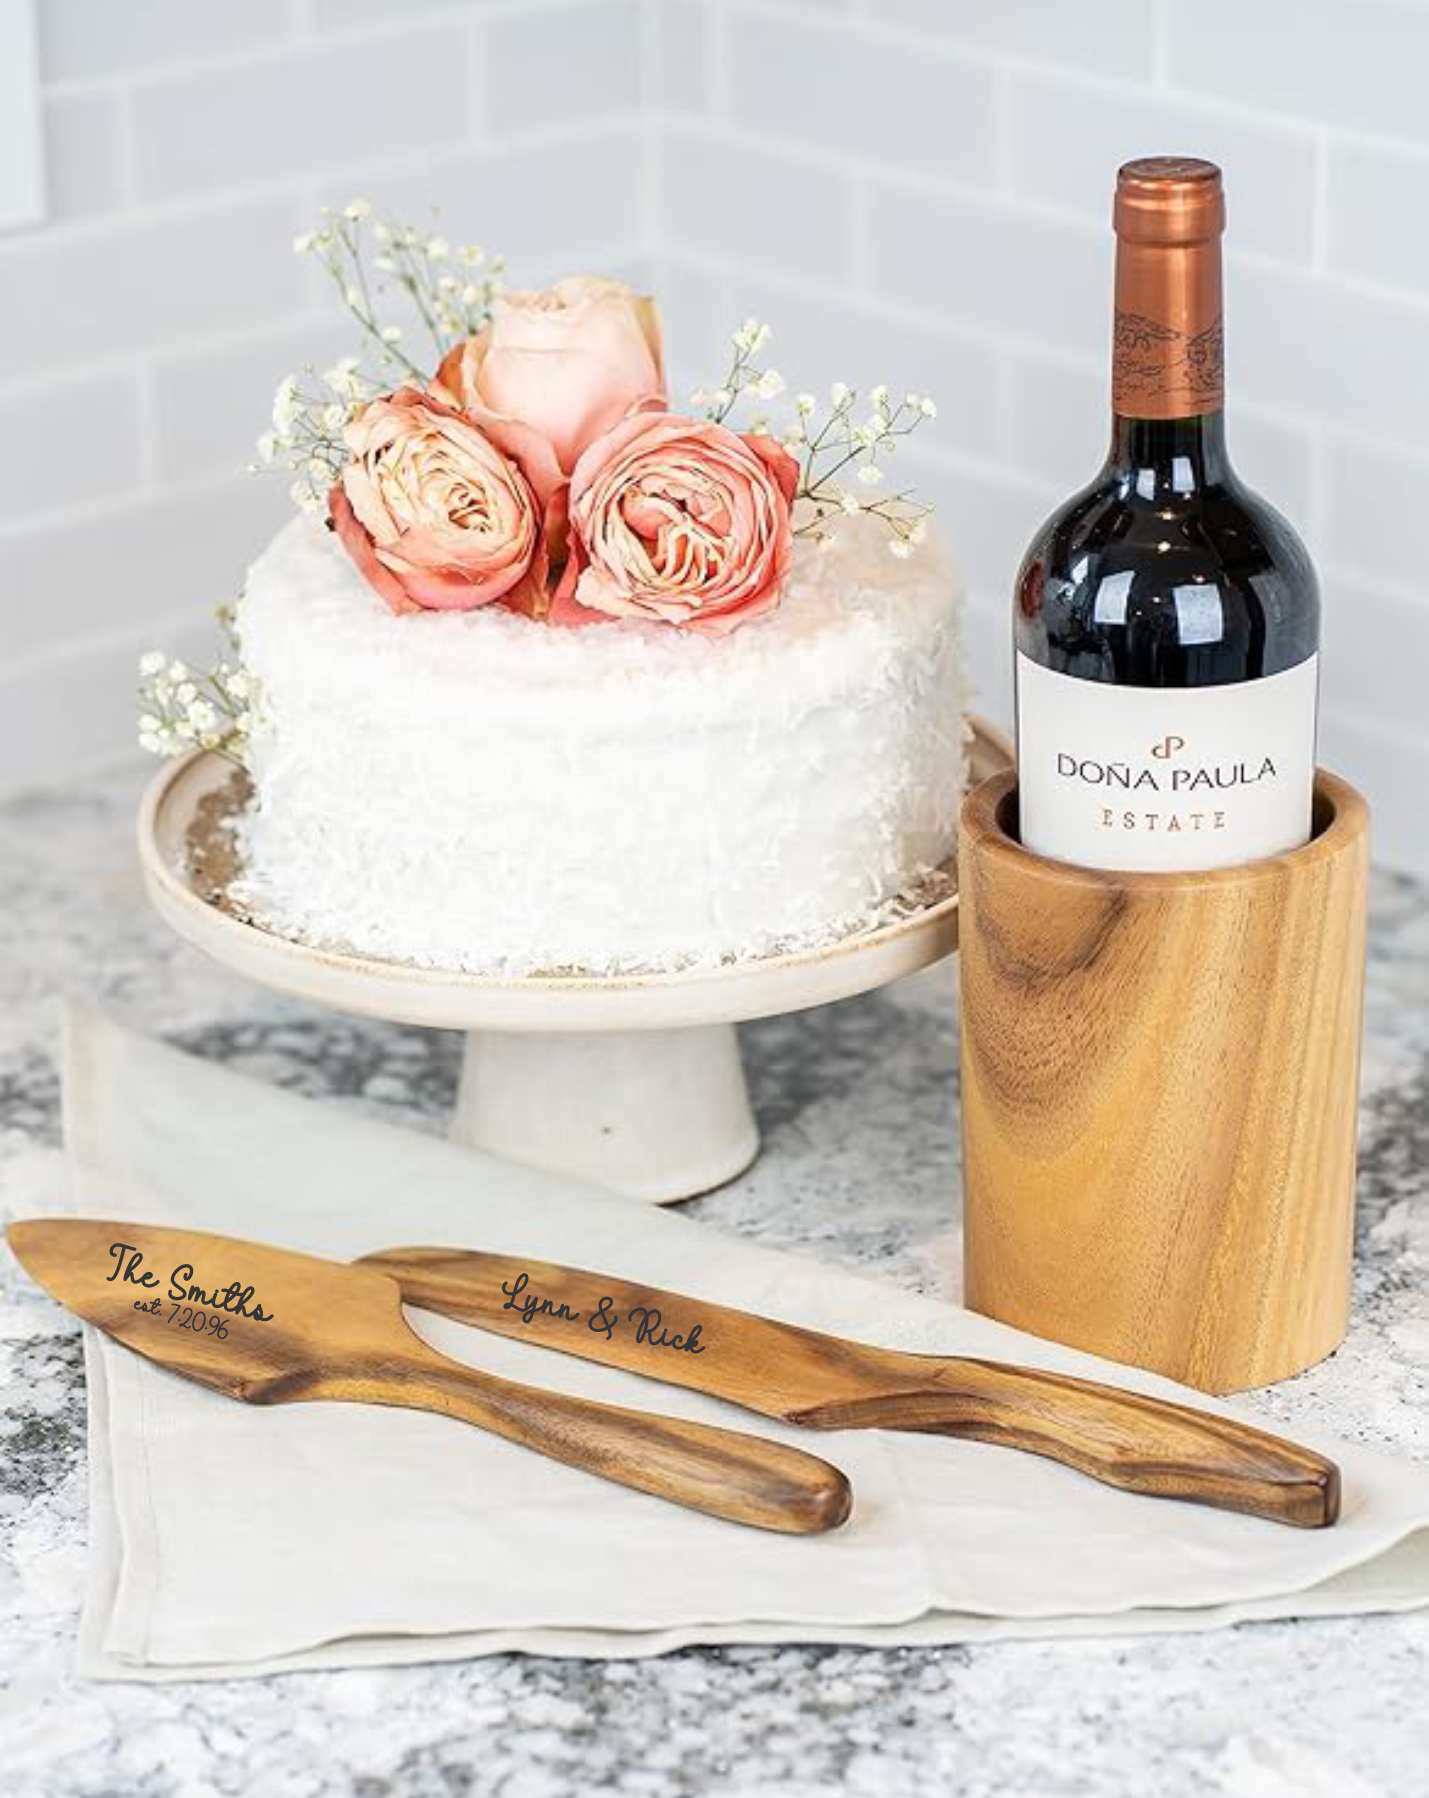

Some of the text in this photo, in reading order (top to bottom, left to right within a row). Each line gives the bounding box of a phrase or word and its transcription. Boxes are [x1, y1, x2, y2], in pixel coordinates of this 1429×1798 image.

[1057, 752, 1277, 791] DOÑA PAULA
[1101, 808, 1226, 832] ESTATE
[106, 1242, 275, 1322] The Smiths
[133, 1297, 231, 1340] est. 7.20.96
[501, 1272, 706, 1354] Lynn & Rick
